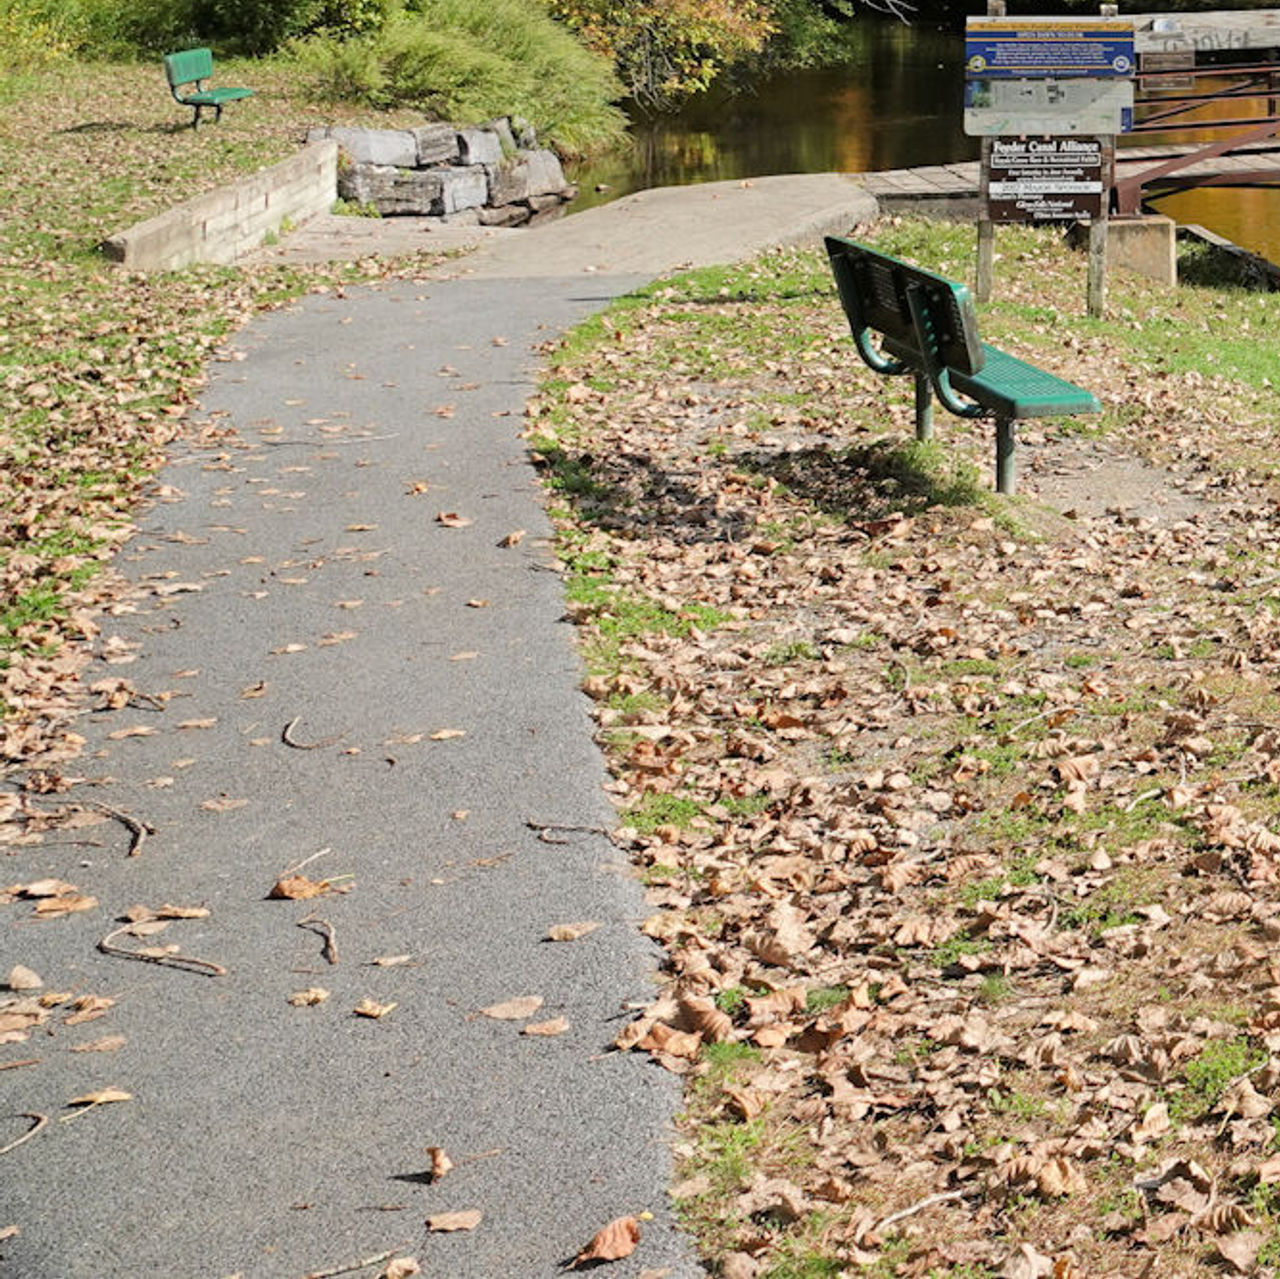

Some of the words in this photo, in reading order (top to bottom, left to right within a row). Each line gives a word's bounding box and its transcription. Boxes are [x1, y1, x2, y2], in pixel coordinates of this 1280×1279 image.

[994, 141, 1025, 153] Feeder
[1029, 141, 1056, 152] Canal
[1060, 141, 1098, 153] Alliance
